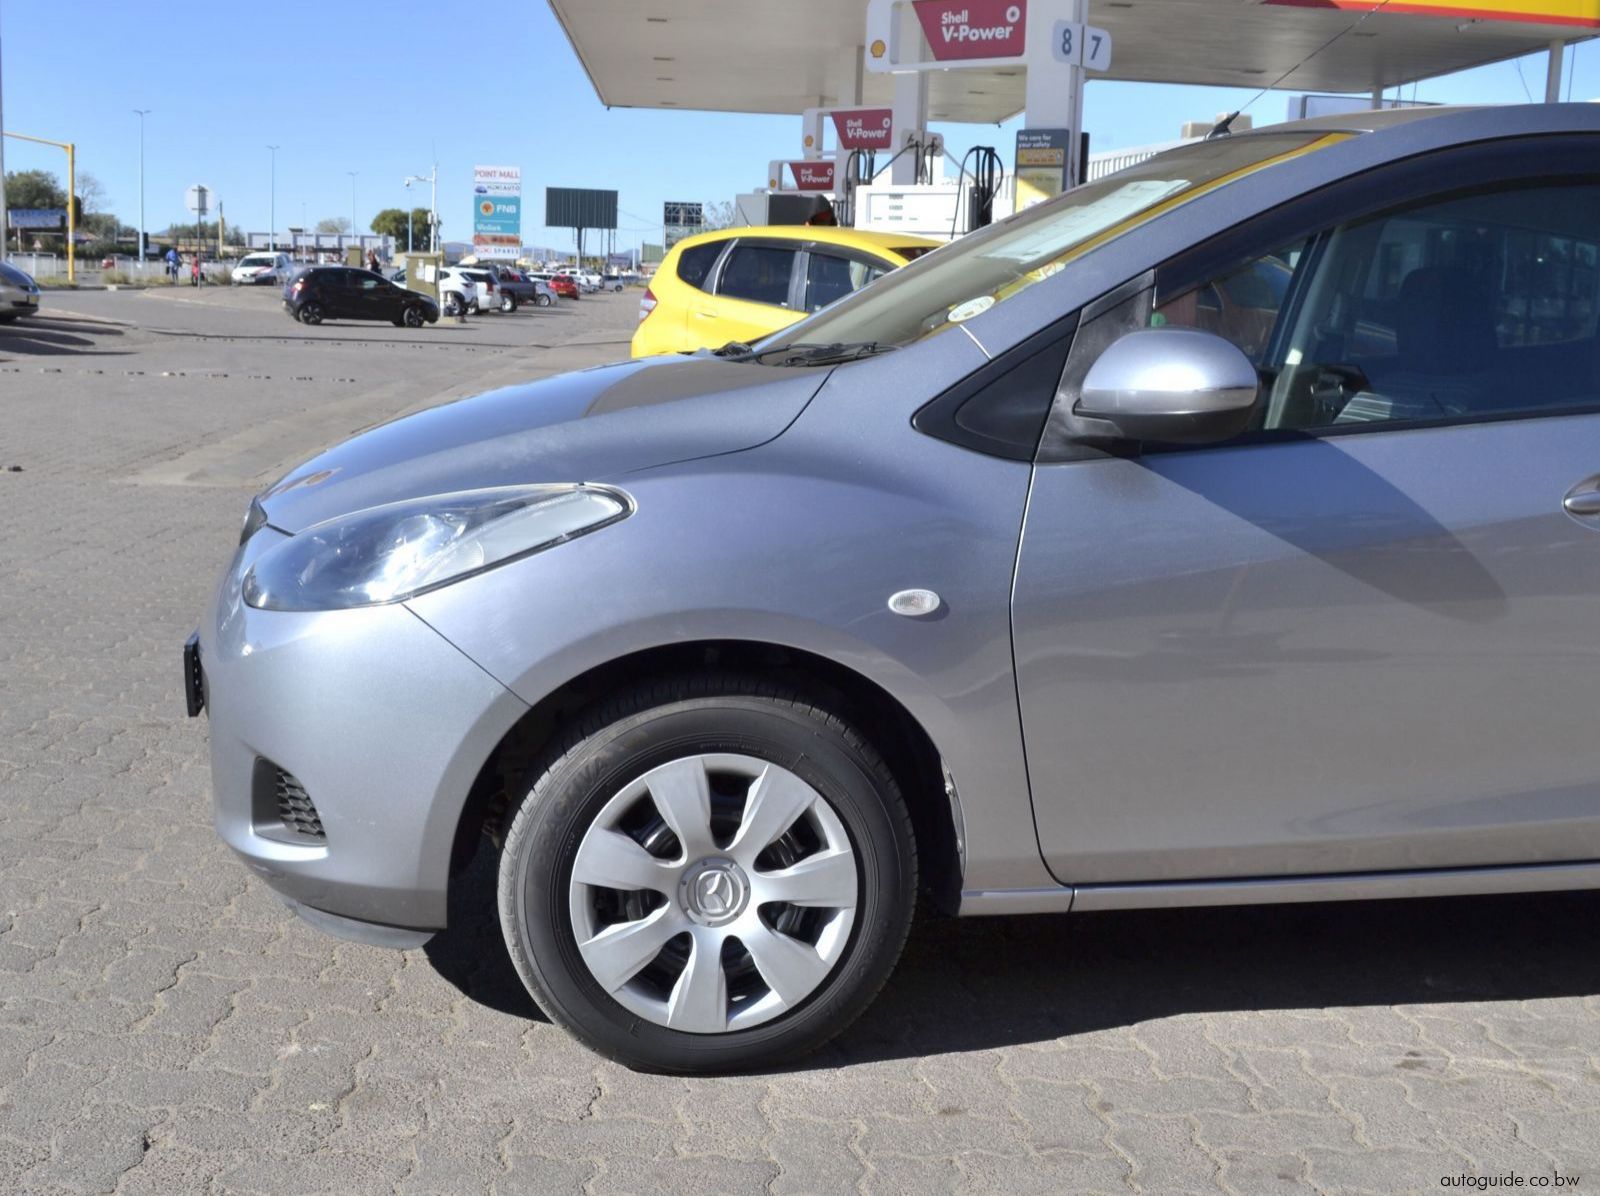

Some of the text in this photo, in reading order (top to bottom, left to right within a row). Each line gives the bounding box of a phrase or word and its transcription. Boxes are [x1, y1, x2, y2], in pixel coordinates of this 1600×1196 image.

[941, 10, 968, 25] Shell
[941, 25, 1014, 42] V-Power
[1061, 28, 1072, 55] 8
[1090, 35, 1103, 61] 7
[846, 118, 862, 128] Shell
[846, 128, 887, 139] V-Power
[474, 169, 520, 179] POINT MALL
[800, 175, 831, 183] V-Power
[496, 204, 516, 214] FNB
